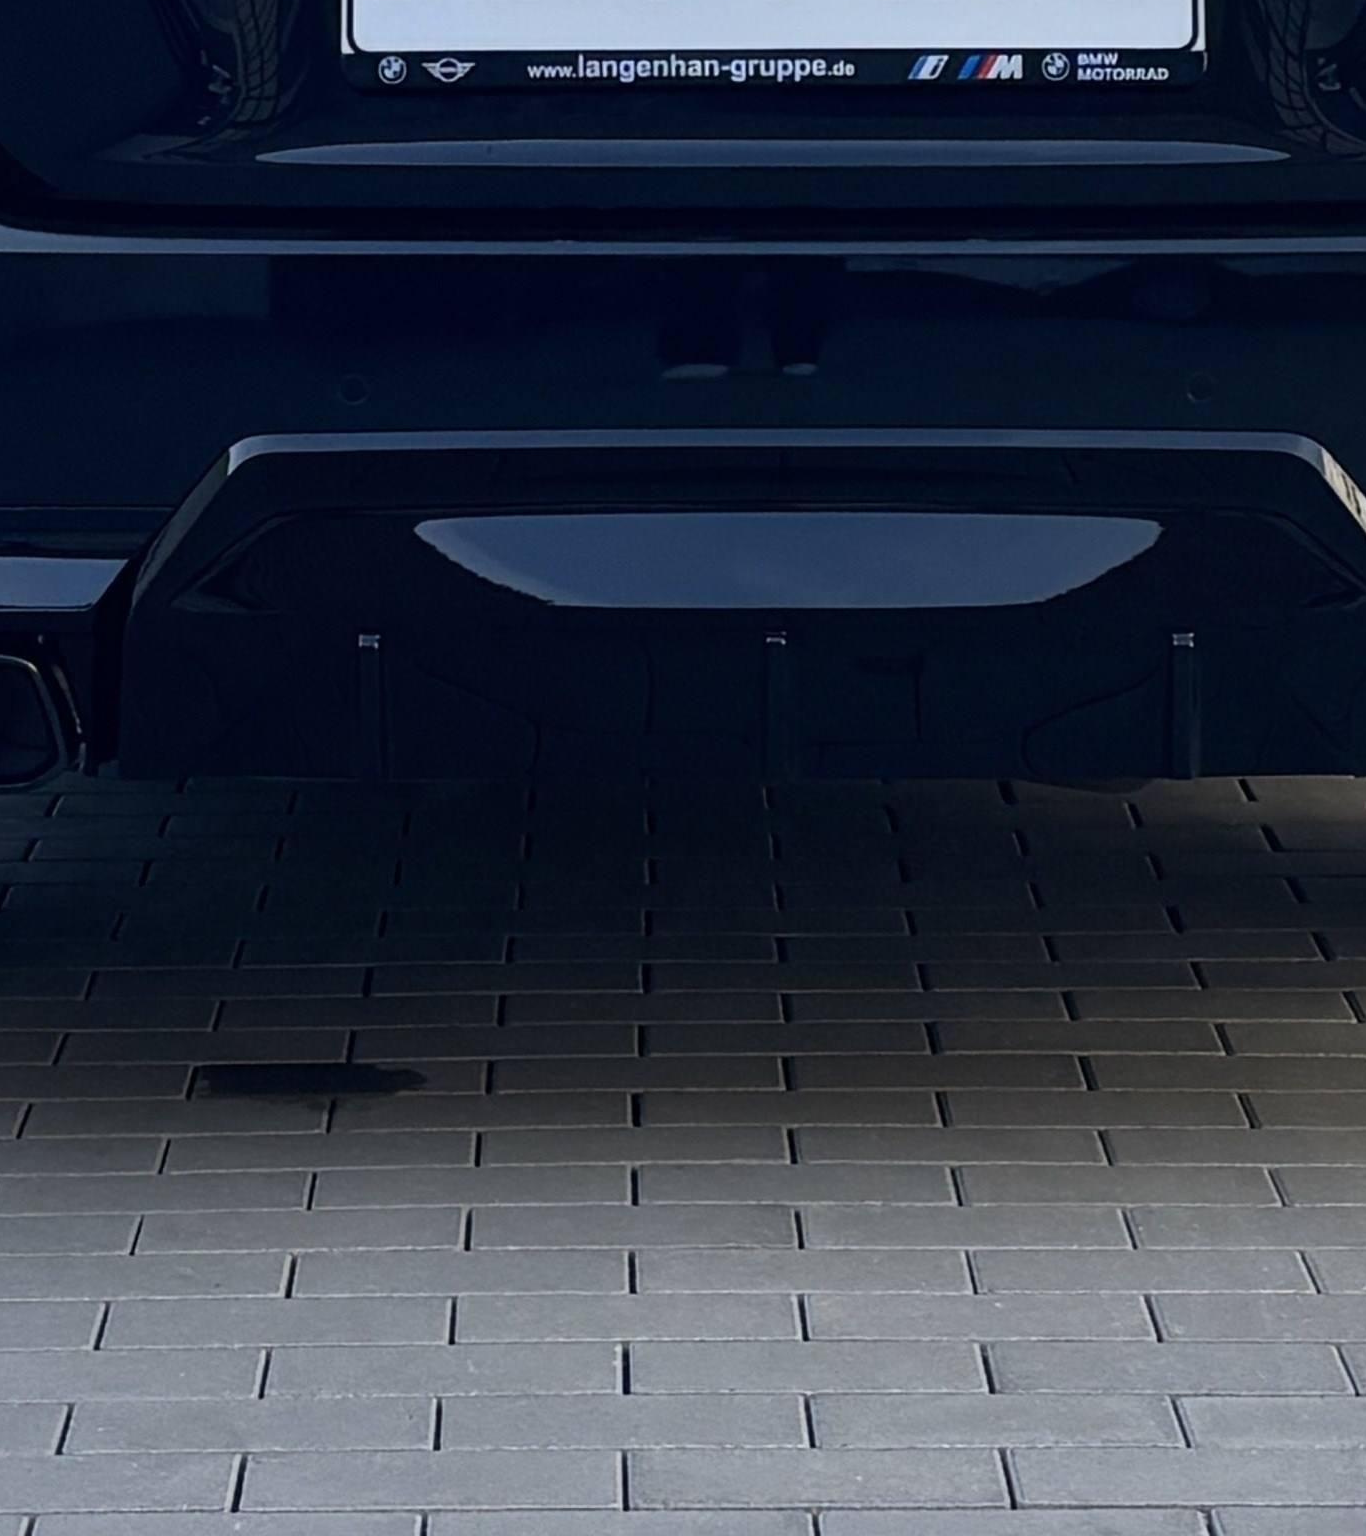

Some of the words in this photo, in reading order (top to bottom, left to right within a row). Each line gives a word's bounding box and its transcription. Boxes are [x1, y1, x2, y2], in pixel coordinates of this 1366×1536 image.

[1077, 53, 1118, 66] BMW
[527, 54, 855, 82] www.langenhan-gruppe.de
[1077, 67, 1169, 82] MOTORRAD
